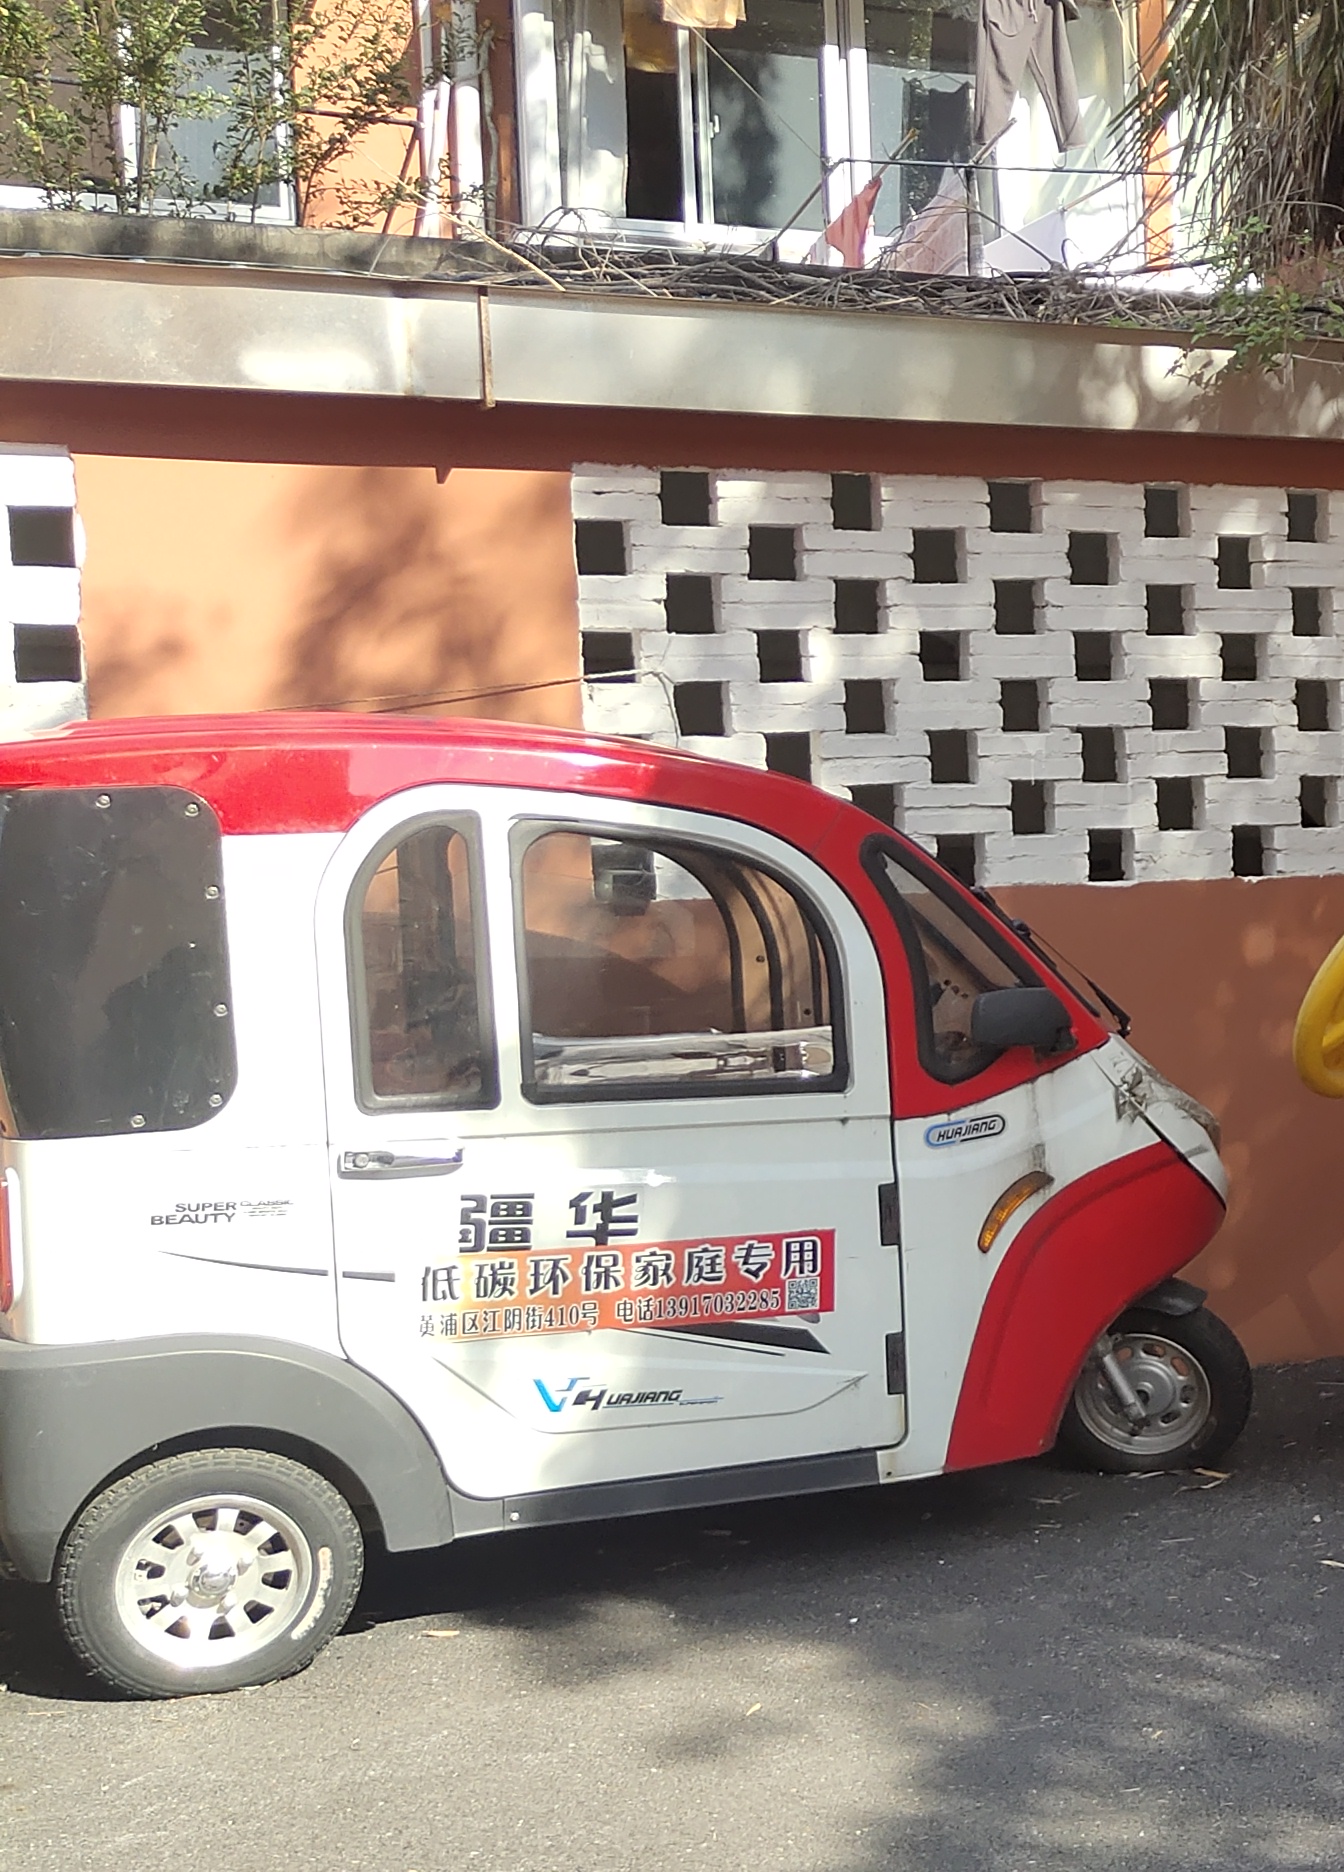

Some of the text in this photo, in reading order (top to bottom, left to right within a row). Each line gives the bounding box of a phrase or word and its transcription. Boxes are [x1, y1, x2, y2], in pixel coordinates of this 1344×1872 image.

[936, 1119, 998, 1142] HUAJIANG
[174, 1201, 237, 1213] SUPER
[150, 1212, 236, 1226] BEAUTY
[420, 1235, 821, 1302] 低碳环保家庭专用
